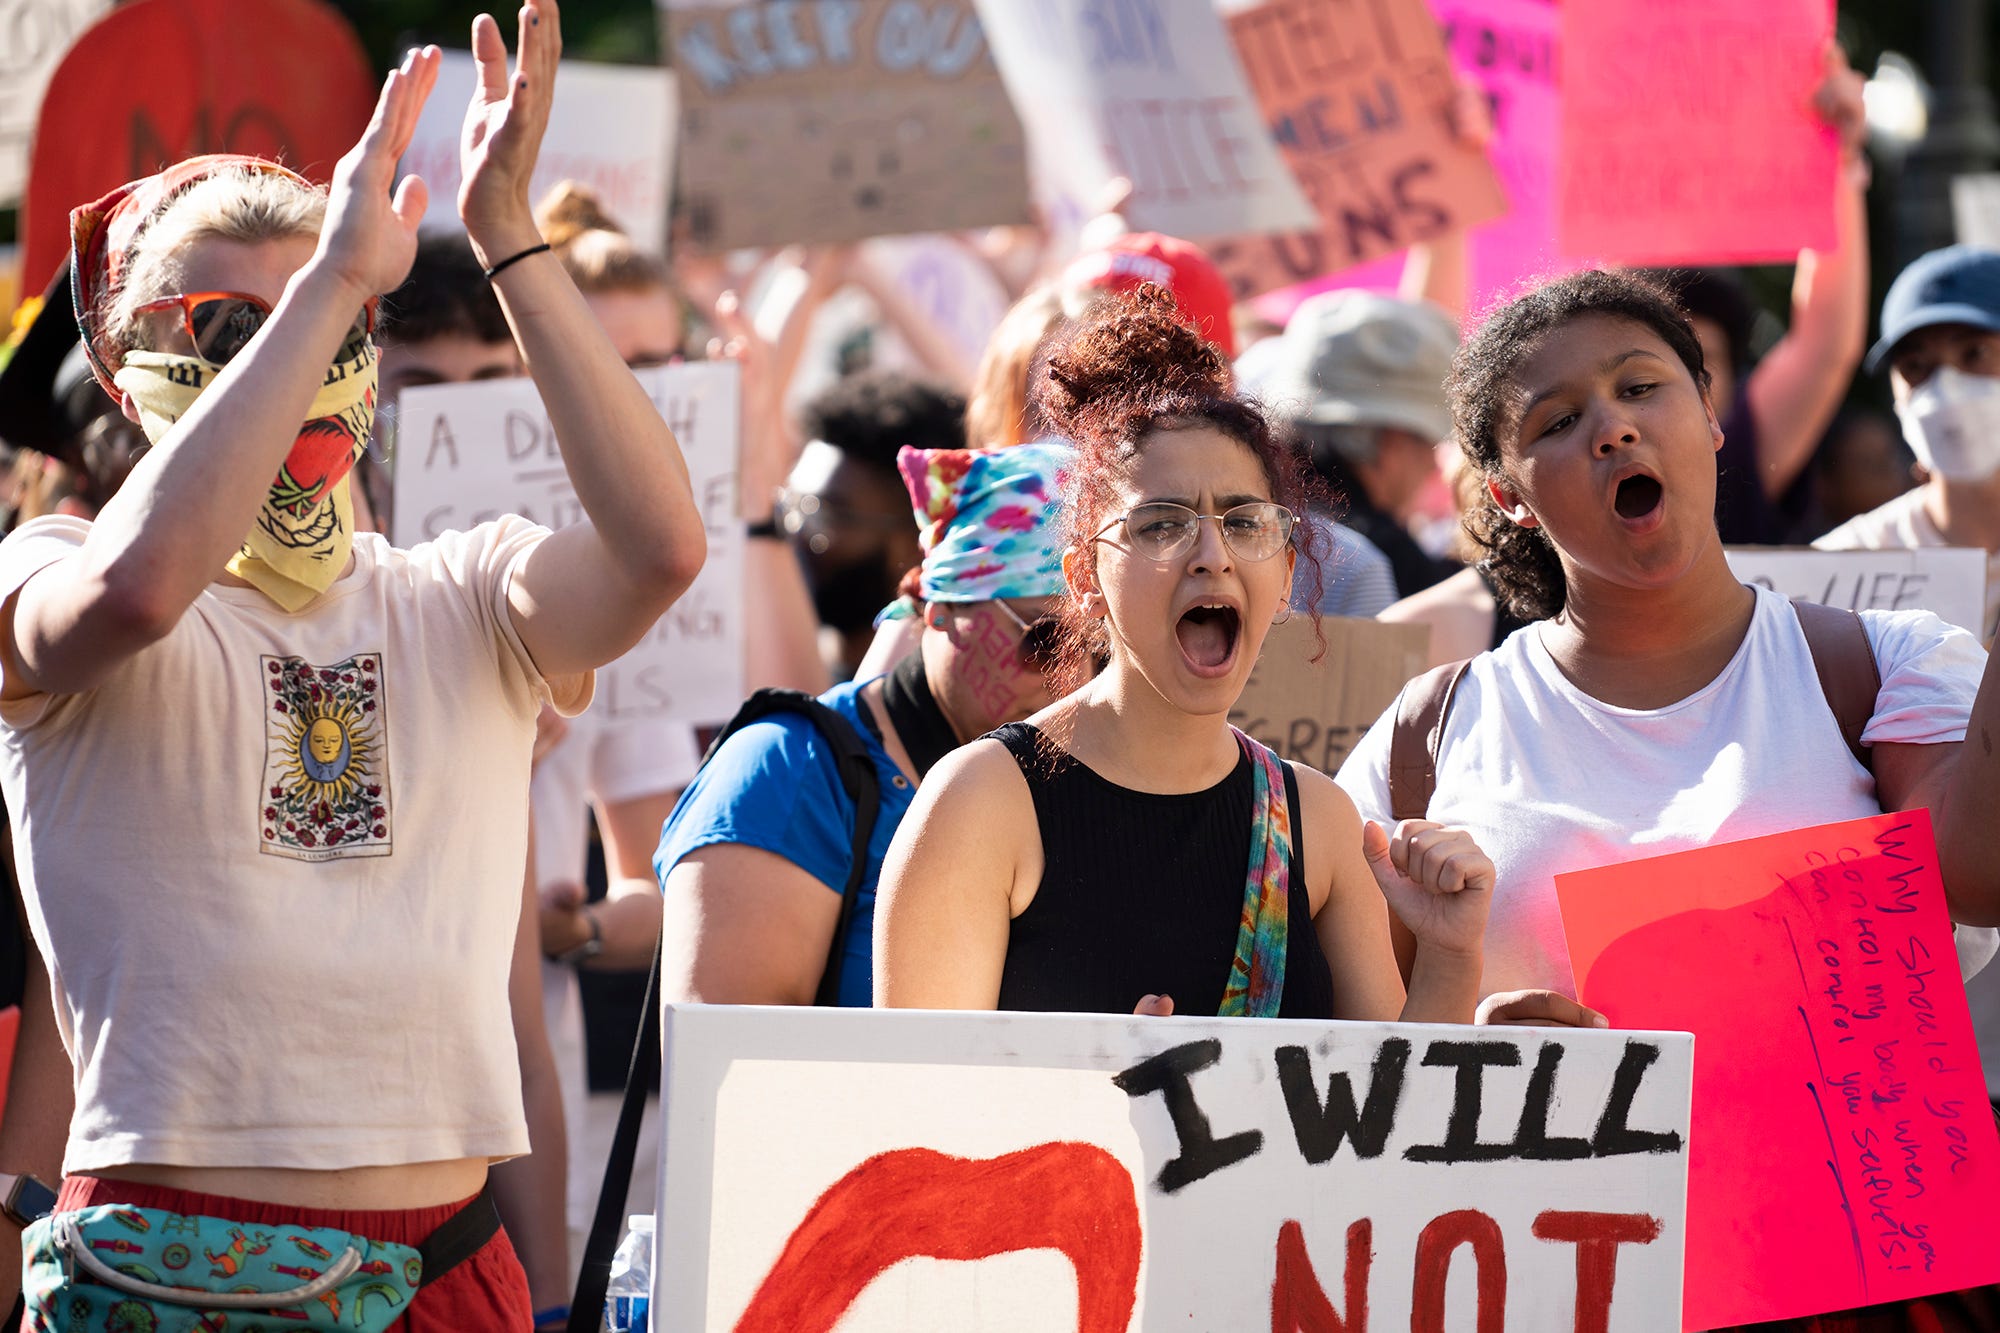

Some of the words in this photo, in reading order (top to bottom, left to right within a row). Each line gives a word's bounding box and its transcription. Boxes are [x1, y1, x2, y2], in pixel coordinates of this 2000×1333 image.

[680, 0, 866, 92] KEEP
[425, 413, 460, 470] A
[1816, 939, 1856, 1044] control
[1851, 983, 1888, 1020] my
[1873, 823, 1925, 914] Why
[1923, 1095, 1969, 1174] you
[1112, 1036, 1265, 1195] I
[1275, 1036, 1685, 1166] WILL
[1872, 1039, 1908, 1106] body
[1893, 1119, 1926, 1199] when
[1270, 1208, 1664, 1333] NOT
[1899, 1221, 1937, 1273] you
